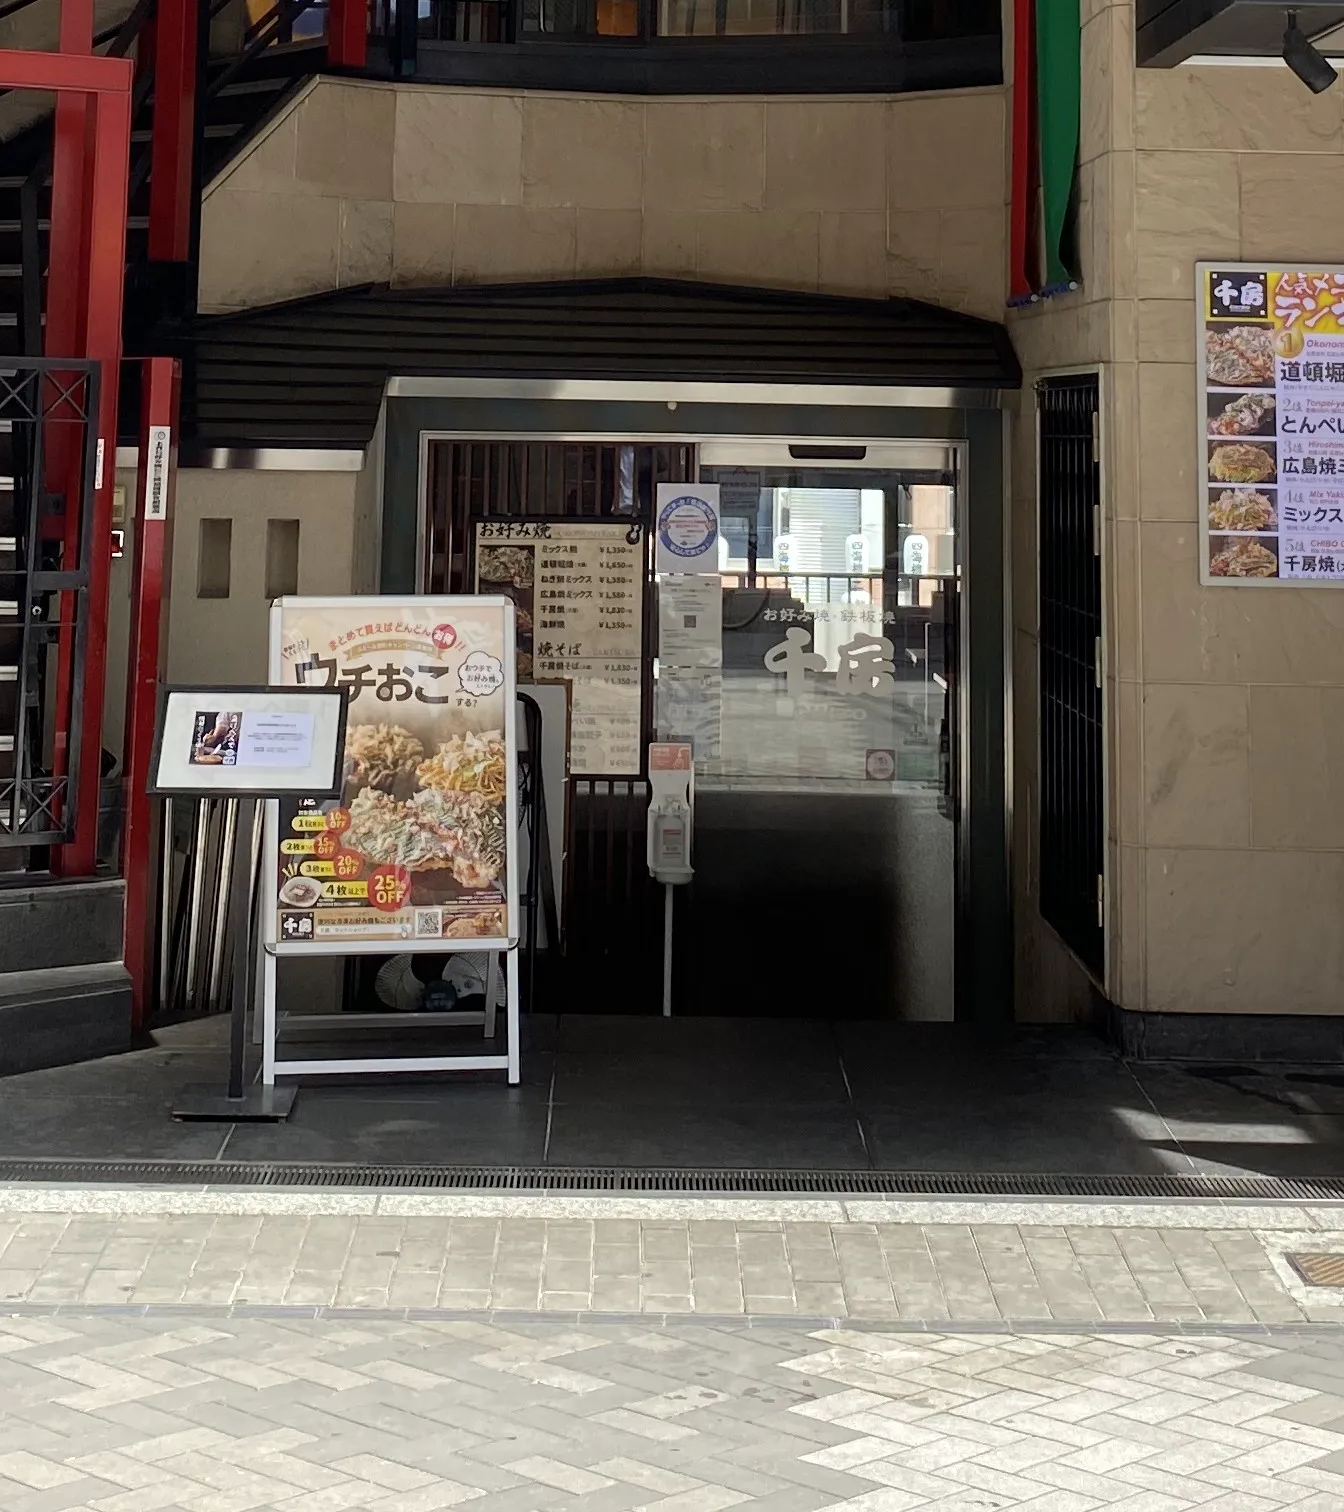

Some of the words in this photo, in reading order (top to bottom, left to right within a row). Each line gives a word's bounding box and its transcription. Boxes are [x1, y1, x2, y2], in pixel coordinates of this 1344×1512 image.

[1214, 280, 1264, 306] 千房
[1280, 333, 1292, 350] 1
[479, 522, 552, 539] お好み焼
[1310, 540, 1337, 548] CHIBO
[537, 643, 582, 657] 焼そば
[764, 626, 896, 697] 千房
[338, 865, 358, 875] OFF
[376, 890, 404, 904] OFF
[283, 917, 313, 934] 千房
